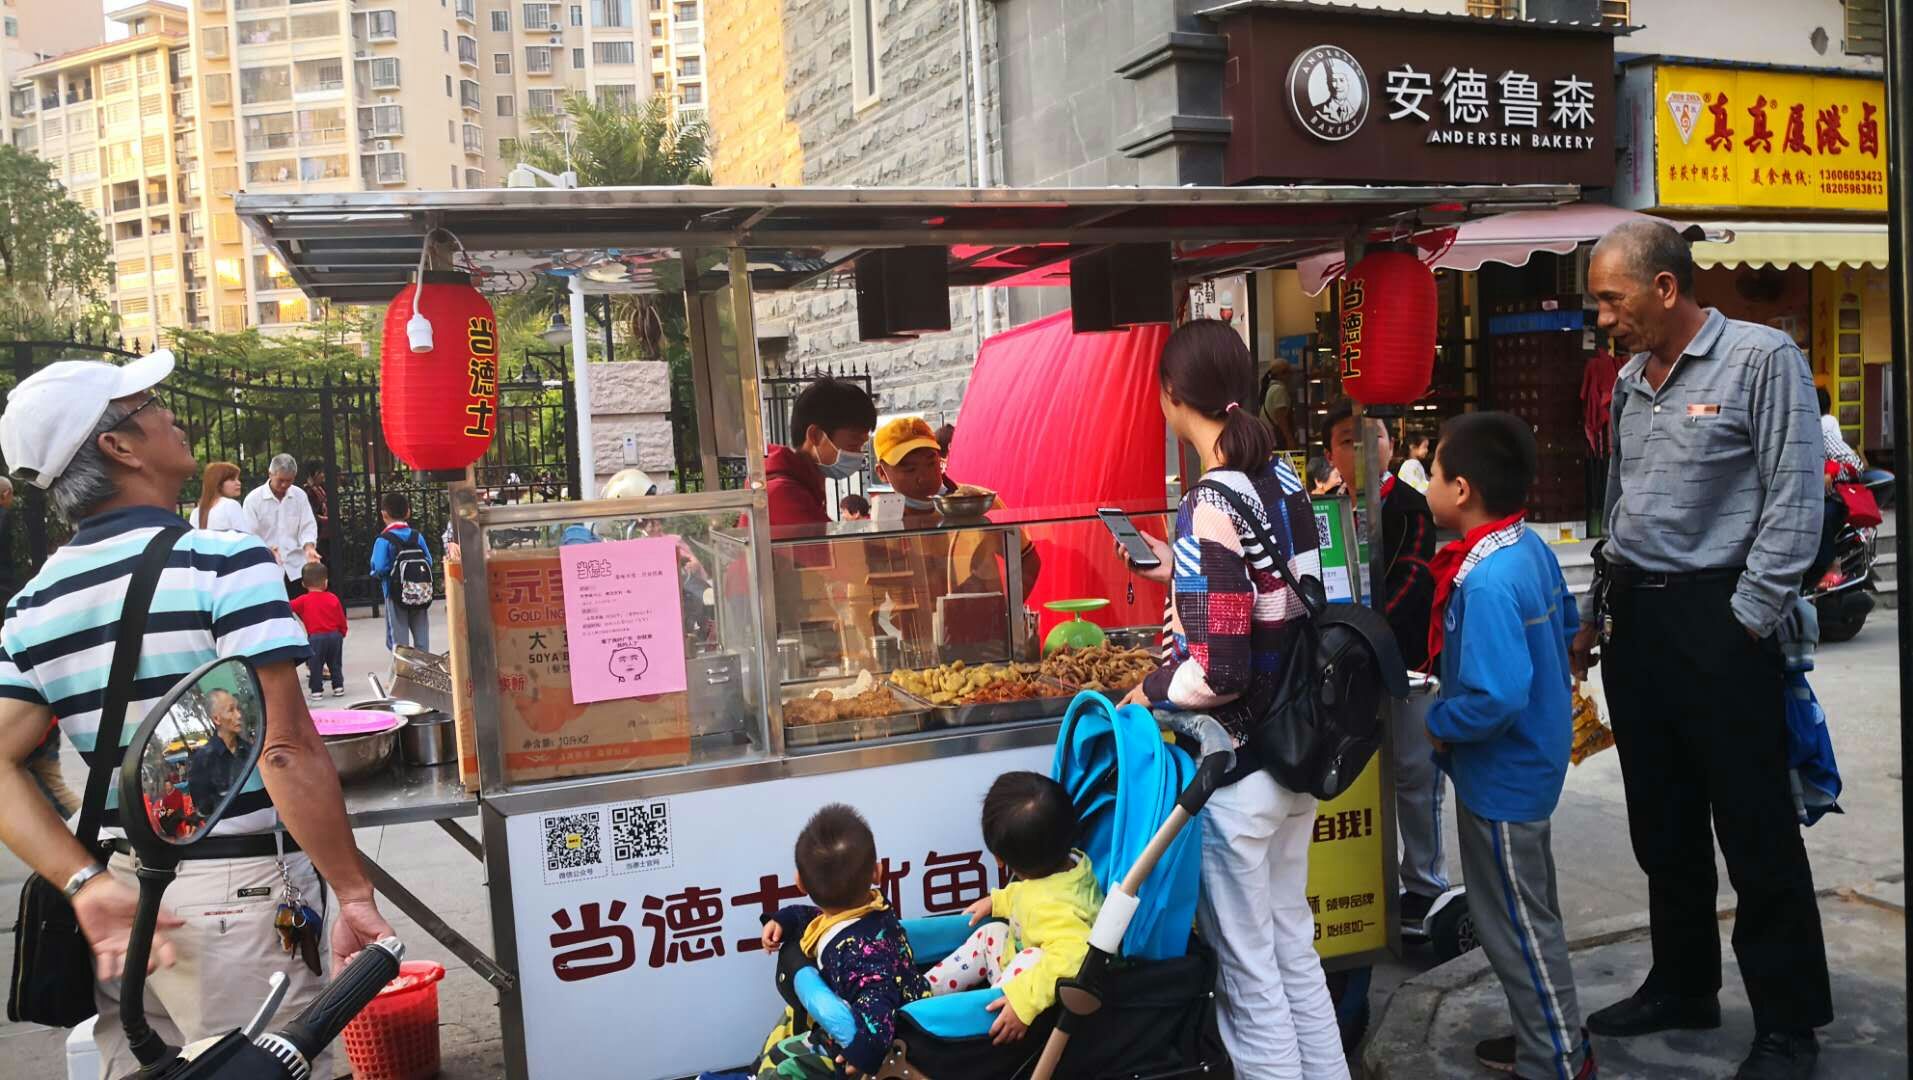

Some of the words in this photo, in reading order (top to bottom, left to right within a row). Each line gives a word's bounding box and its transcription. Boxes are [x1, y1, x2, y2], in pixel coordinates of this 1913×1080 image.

[1386, 63, 1595, 129] 安德鲁森
[1310, 115, 1358, 135] BAKERY
[1429, 130, 1521, 146] ANDERSEN
[1532, 134, 1594, 149] BAKERY
[1669, 164, 1730, 183] 荣获中国名菜
[1819, 169, 1883, 182] 13606053423
[1820, 183, 1884, 195] 18205963813
[465, 317, 496, 437] 当德士
[576, 559, 612, 580] 当德士
[528, 652, 559, 664] SOYA
[1313, 807, 1372, 843] 自我!
[559, 868, 593, 880] 微信公众号
[626, 859, 660, 870] 当德士官网
[1326, 893, 1375, 912] 领导品牌
[1327, 920, 1375, 938] 始终如一
